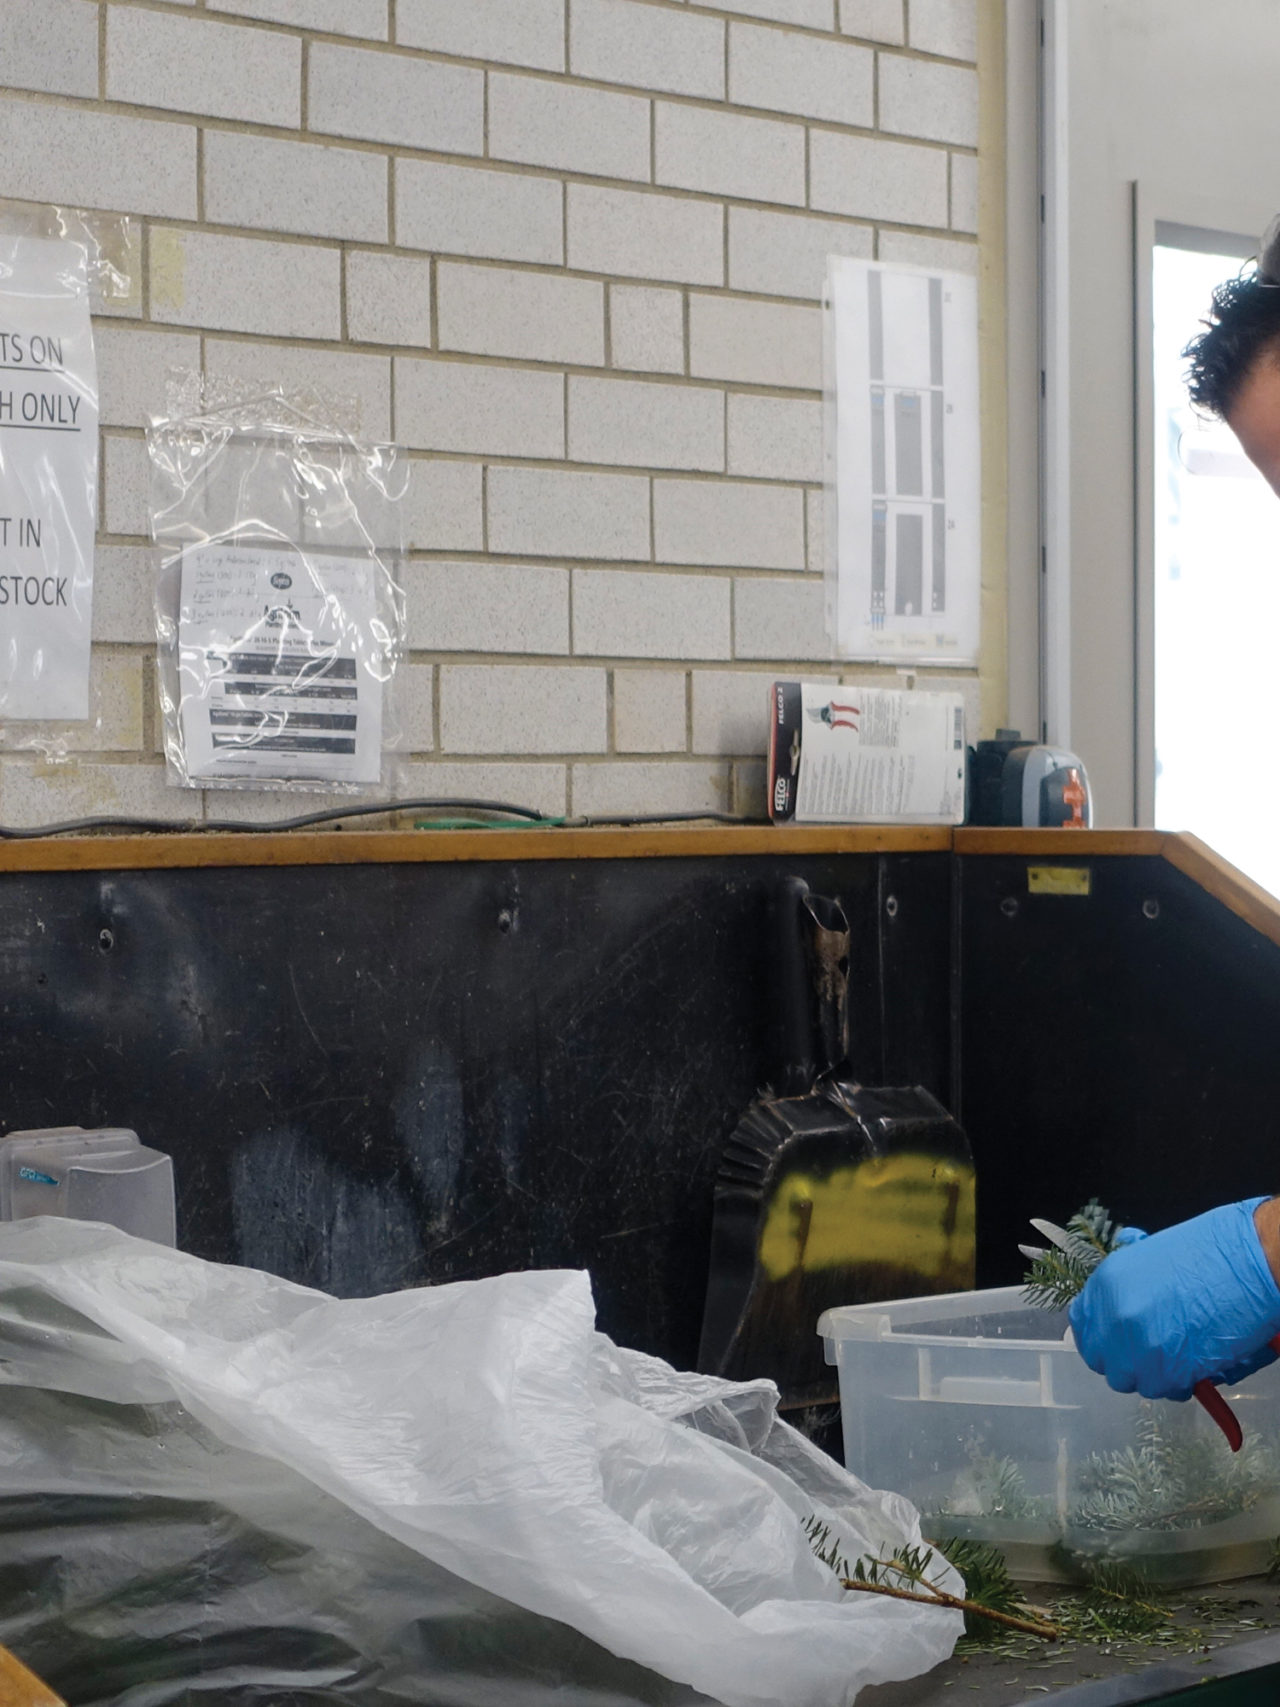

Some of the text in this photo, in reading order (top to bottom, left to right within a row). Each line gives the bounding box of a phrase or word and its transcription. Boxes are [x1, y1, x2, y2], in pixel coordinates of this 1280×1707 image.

[30, 336, 63, 365] ON
[22, 392, 80, 424] ONLY
[0, 517, 41, 547] T IN
[0, 576, 67, 606] STOCK
[777, 695, 785, 725] FELCO
[774, 777, 787, 812] FELCO
